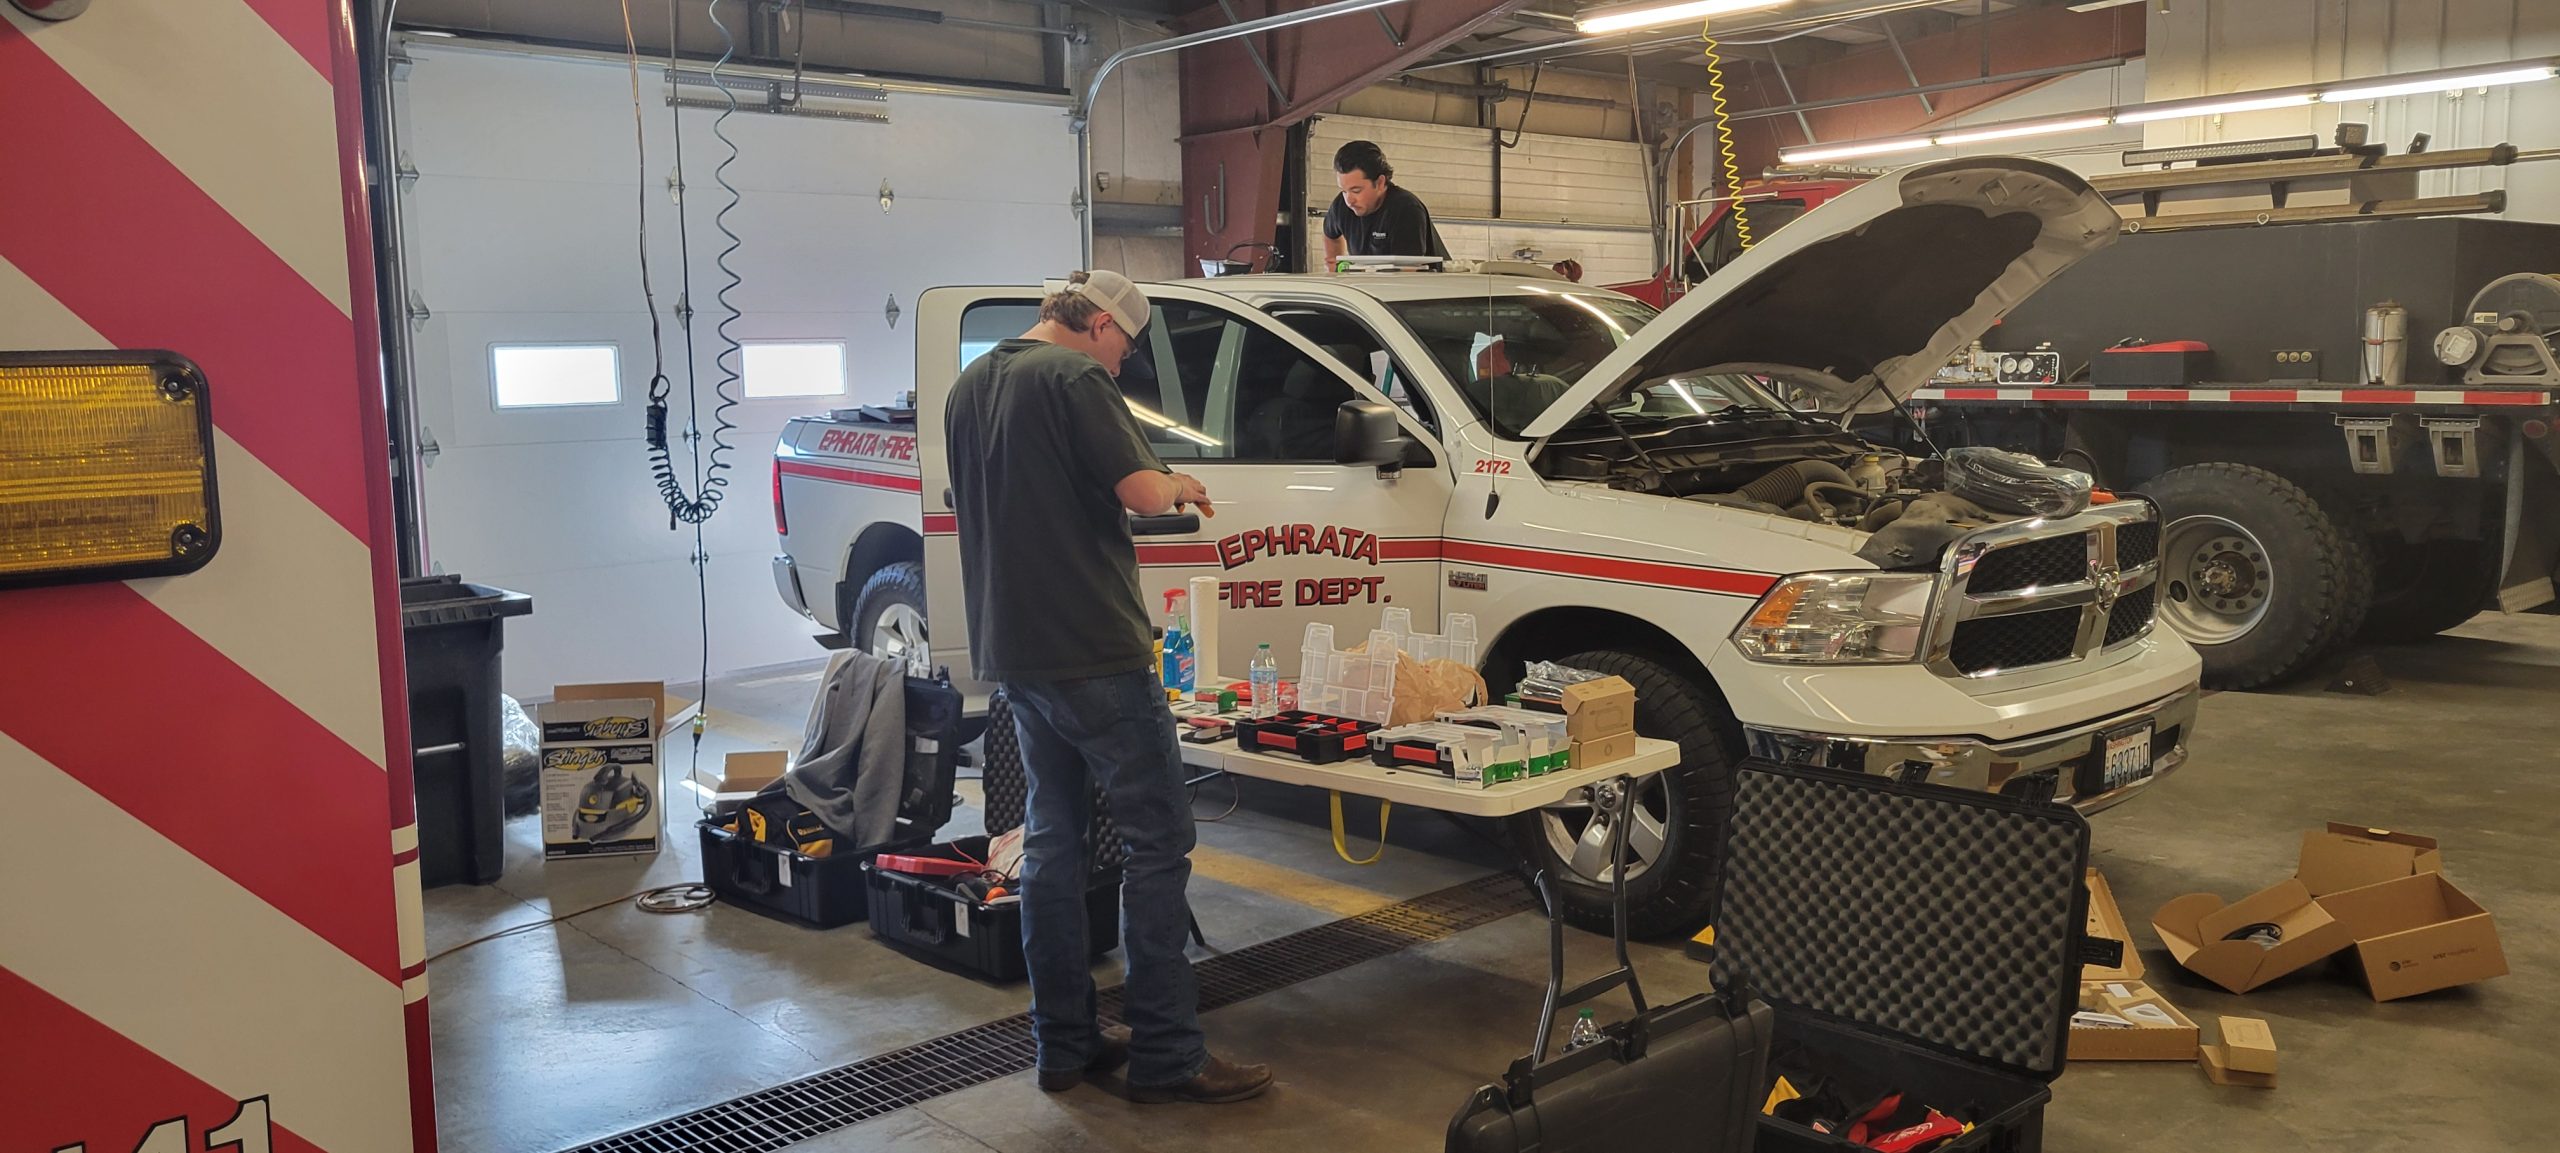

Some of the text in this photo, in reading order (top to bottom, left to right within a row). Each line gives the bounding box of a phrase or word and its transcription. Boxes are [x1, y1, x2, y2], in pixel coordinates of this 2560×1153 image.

[818, 429, 916, 460] EPHRATA FIRE
[1474, 459, 1511, 474] 2172
[1217, 524, 1378, 570] EPHRATA
[1295, 576, 1391, 607] DEPT.
[544, 748, 607, 771] Stinger
